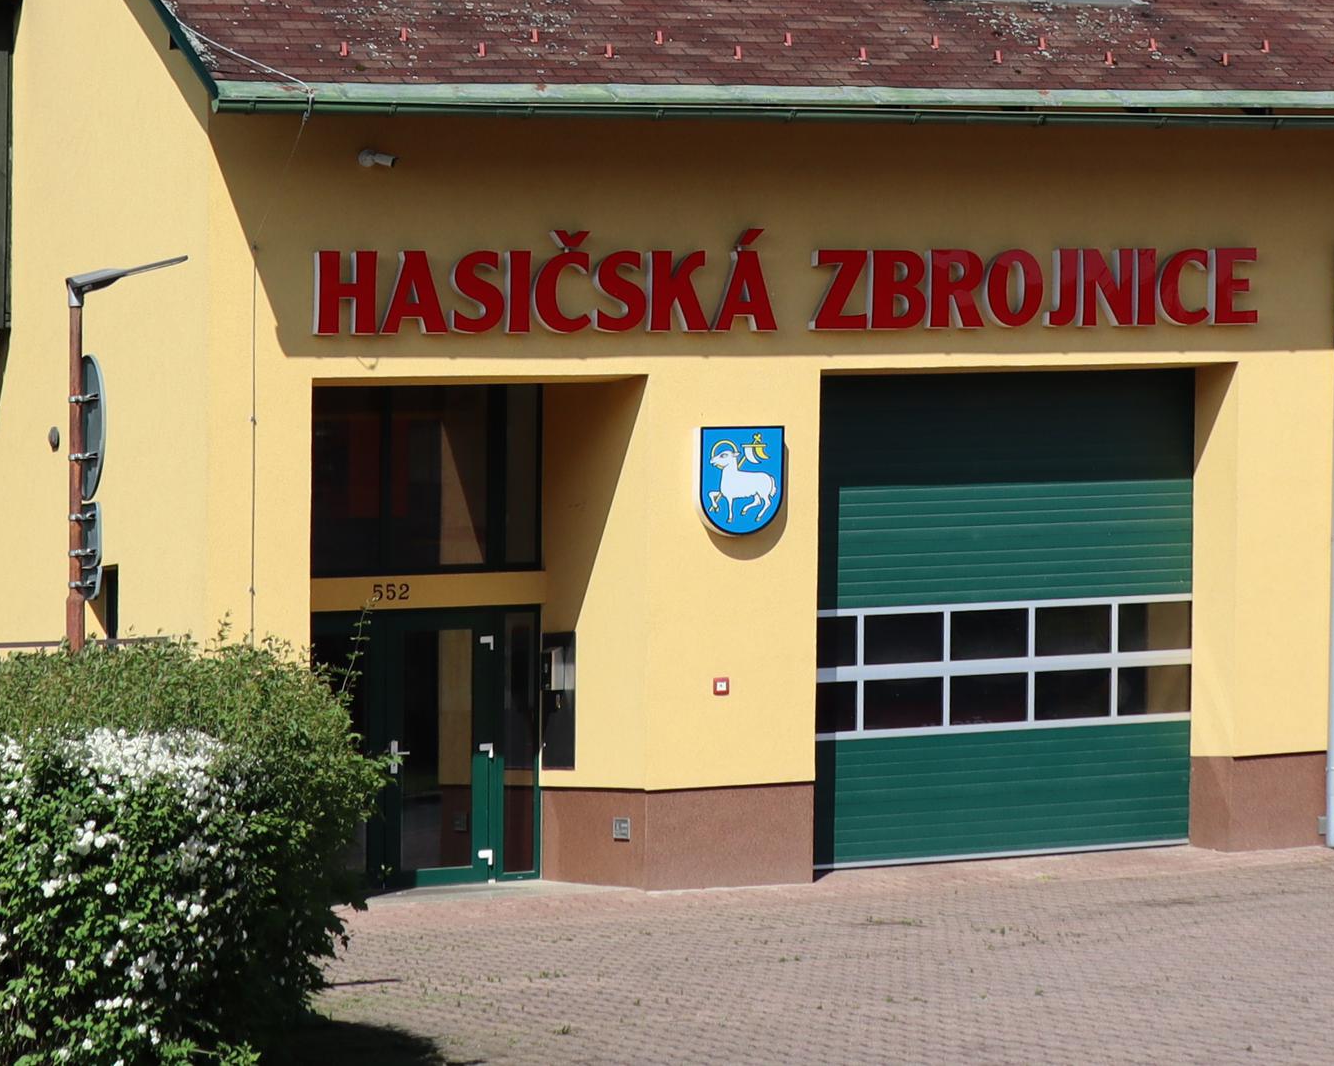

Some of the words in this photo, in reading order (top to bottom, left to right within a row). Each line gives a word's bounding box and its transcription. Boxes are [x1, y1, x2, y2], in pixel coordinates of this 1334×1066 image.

[313, 228, 778, 335] HASIČSKÁ
[807, 247, 1259, 330] ZBROJNICE
[372, 583, 410, 601] 552
